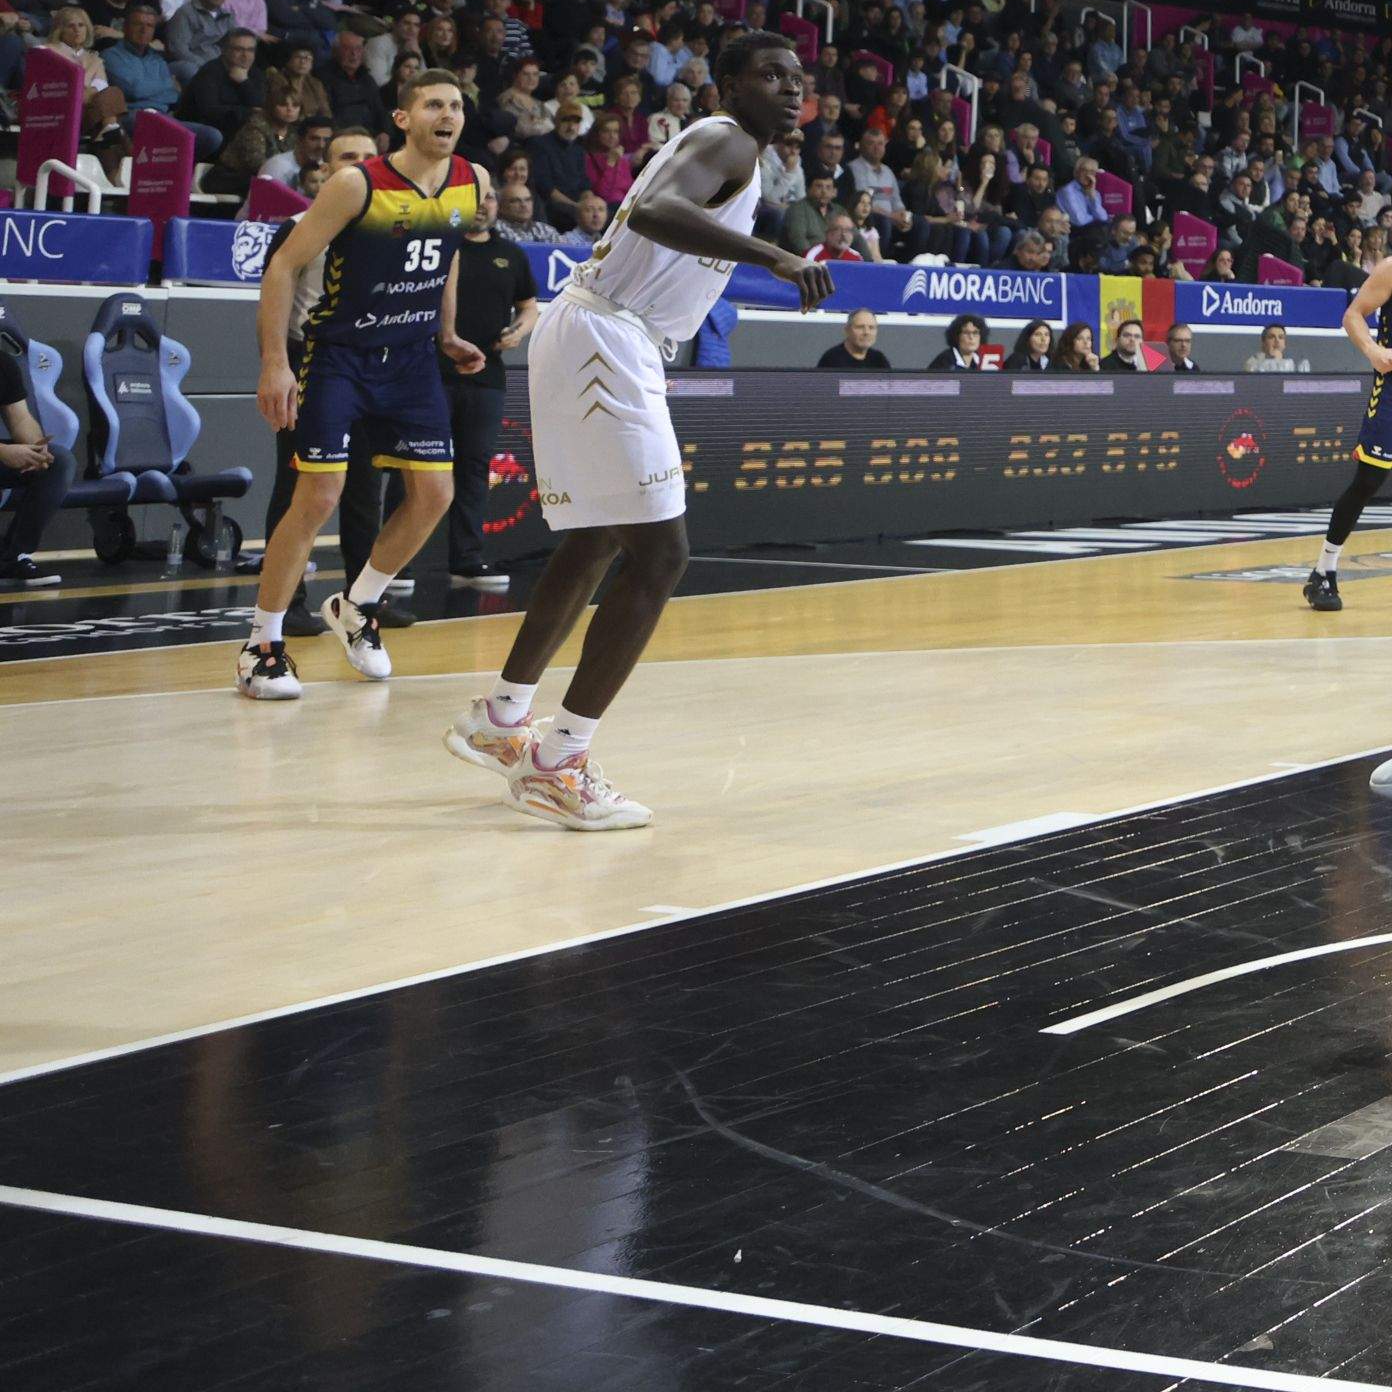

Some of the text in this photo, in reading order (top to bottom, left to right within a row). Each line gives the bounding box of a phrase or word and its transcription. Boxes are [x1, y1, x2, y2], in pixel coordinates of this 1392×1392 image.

[404, 238, 442, 272] 35
[928, 273, 1054, 306] MORABANC
[1220, 292, 1284, 316] Andorra
